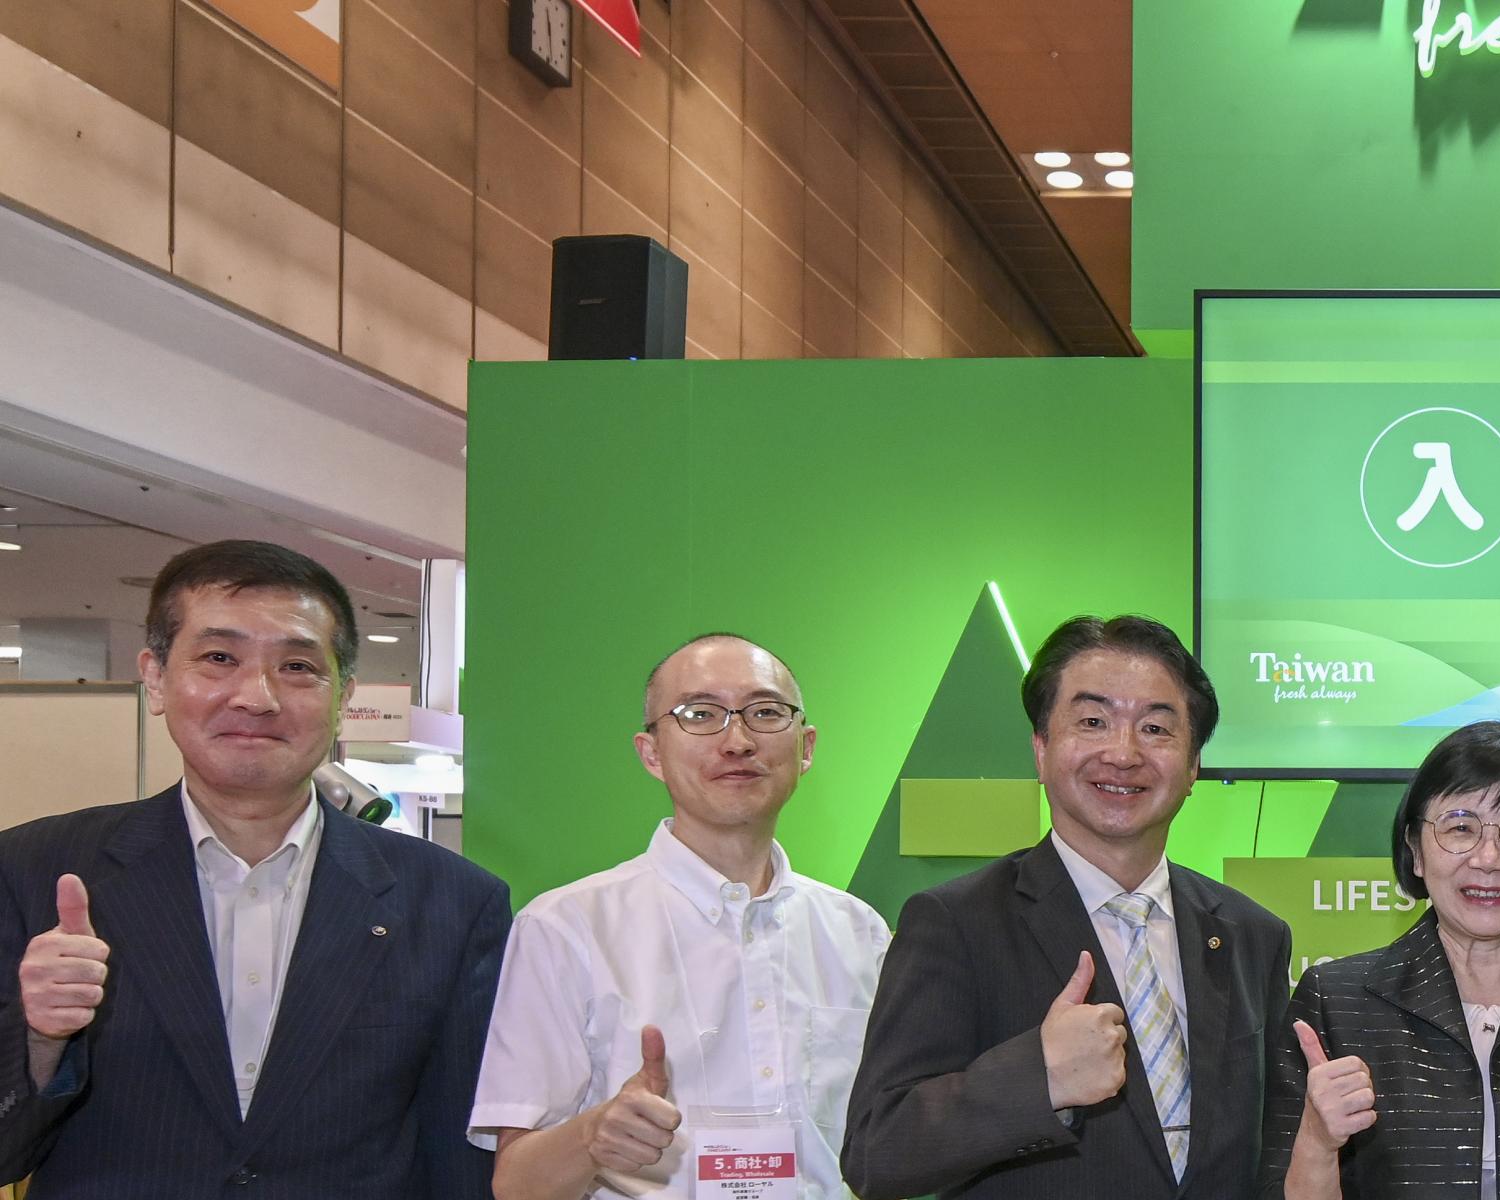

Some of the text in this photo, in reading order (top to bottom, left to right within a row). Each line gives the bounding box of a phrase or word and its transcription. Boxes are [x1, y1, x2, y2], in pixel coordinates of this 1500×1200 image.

[1249, 651, 1376, 683] Taiwan
[1274, 684, 1358, 704] fresh always
